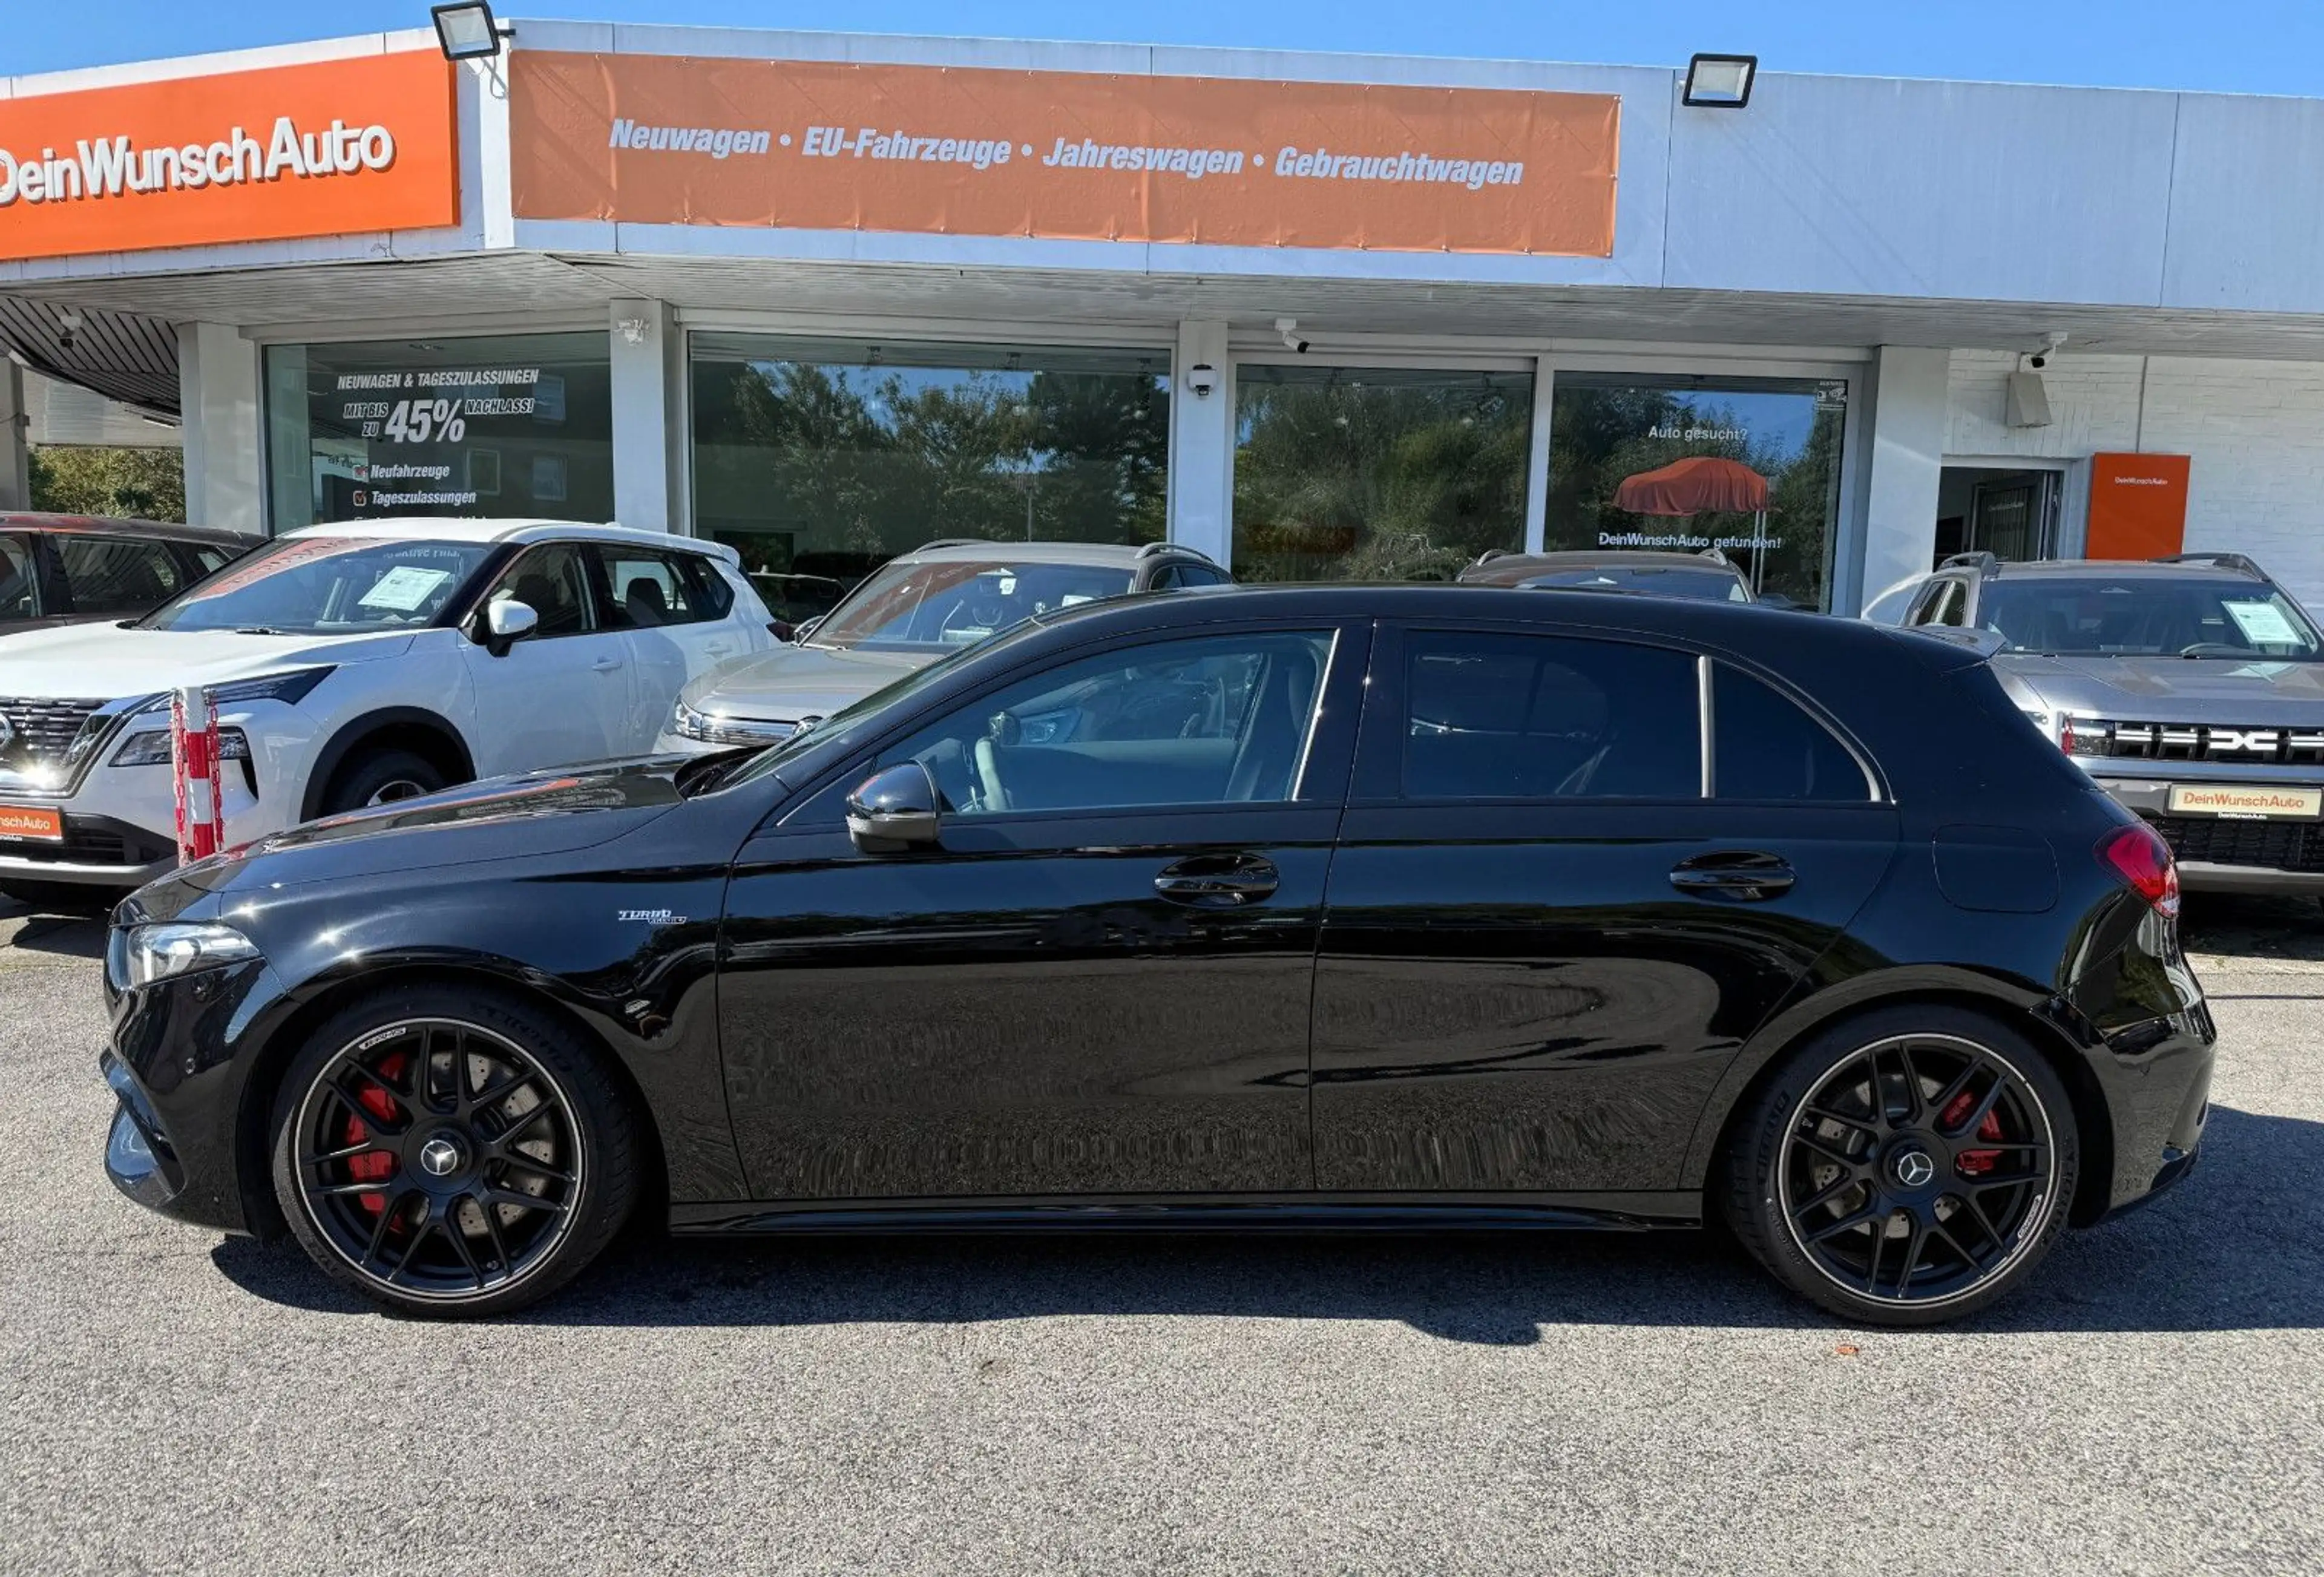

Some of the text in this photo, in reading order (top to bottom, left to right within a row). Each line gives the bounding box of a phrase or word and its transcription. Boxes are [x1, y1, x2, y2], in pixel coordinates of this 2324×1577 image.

[609, 118, 1523, 189] Neuwagen EU-Fahrzeuge Jahreswagen Gebrauchtwagen
[337, 369, 539, 390] NEUWAGEN & TAGESZULASSUNGEN
[343, 402, 389, 419] MIT BIS
[464, 398, 535, 415] NACHLASS!
[384, 398, 465, 443] 45%
[362, 422, 380, 437] ZU
[1648, 426, 1748, 442] Auto gesucht?
[370, 464, 450, 480] Neufahrzeuge
[371, 491, 477, 507] Tageszulassungen
[1598, 533, 1782, 550] DeinWunschAuto gefunden!
[2184, 792, 2305, 808] DeinWunschAuto
